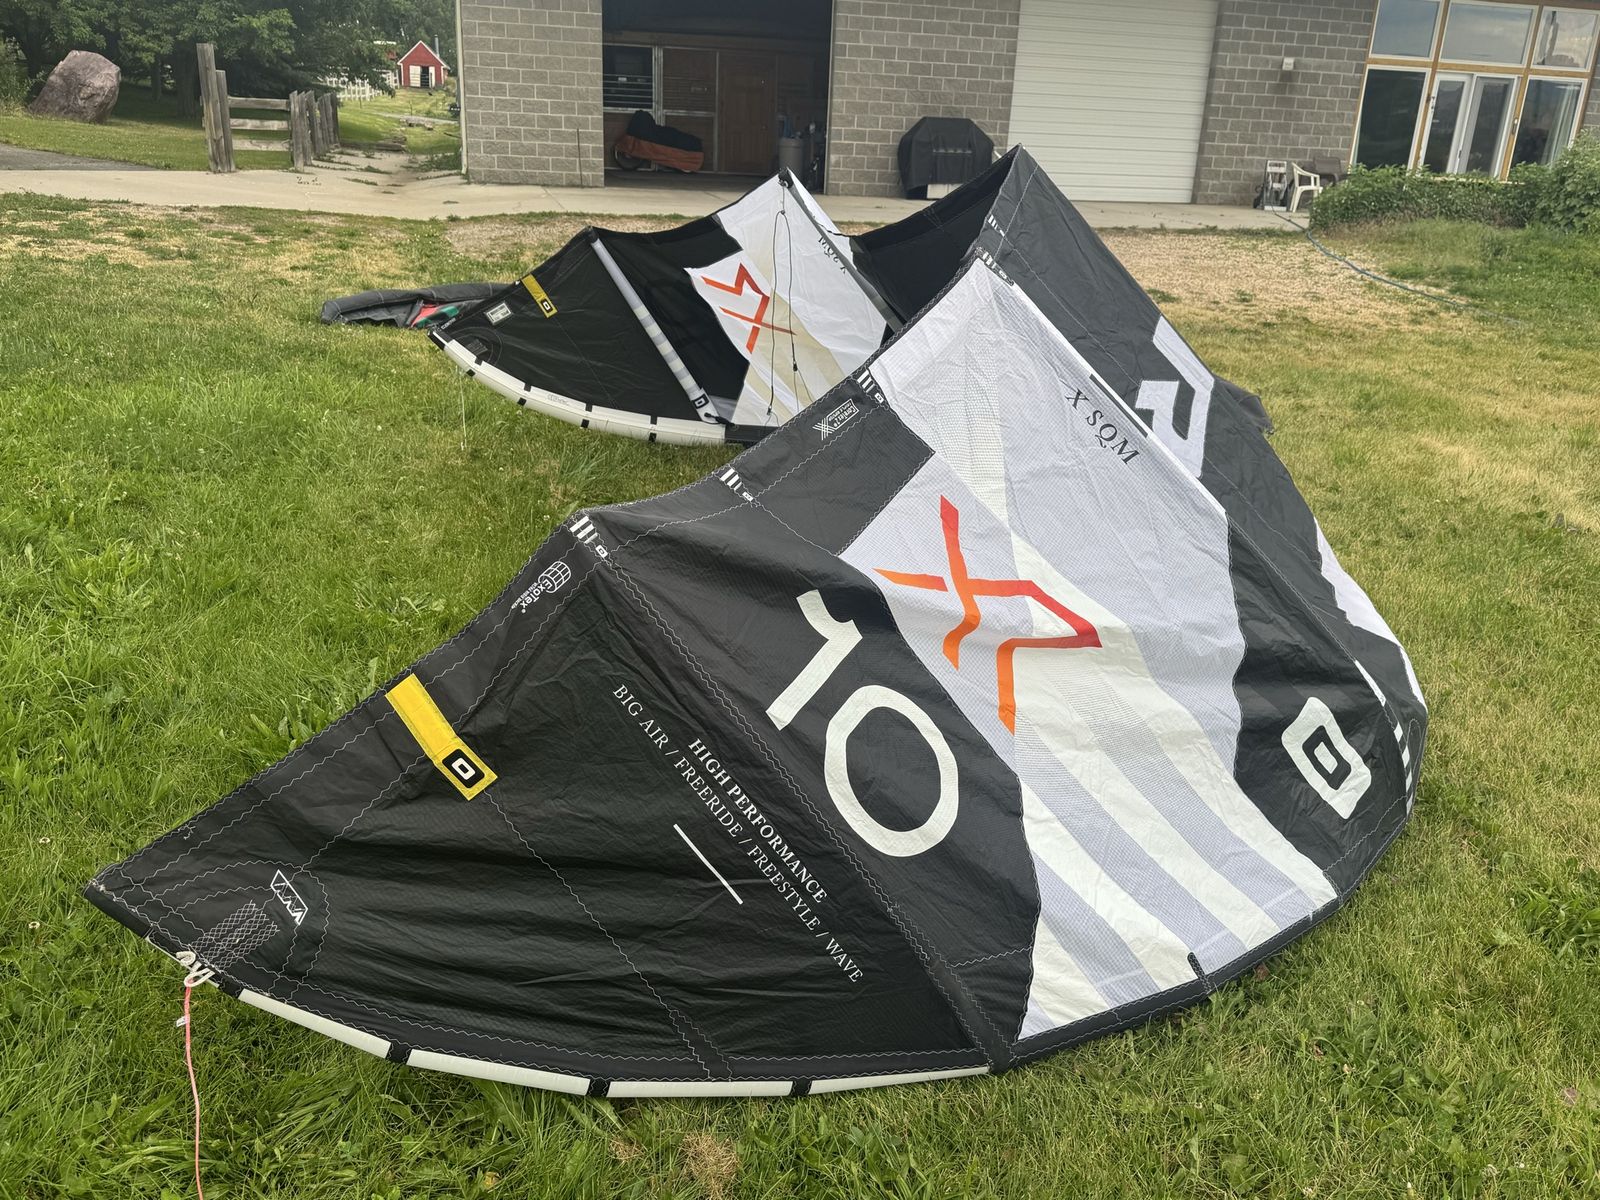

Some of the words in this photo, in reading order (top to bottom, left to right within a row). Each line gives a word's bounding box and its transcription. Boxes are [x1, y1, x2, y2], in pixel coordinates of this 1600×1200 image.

[1064, 388, 1089, 409] X
[1085, 409, 1140, 465] SQM
[688, 738, 731, 787] HIGH
[726, 784, 827, 903] PERFORMANCE
[765, 589, 959, 857] 10
[613, 684, 643, 716] BIG
[640, 717, 670, 749] AIR
[673, 757, 744, 838] FREERIDE
[747, 845, 821, 931] FREESTYLE
[825, 937, 864, 983] WAVE
